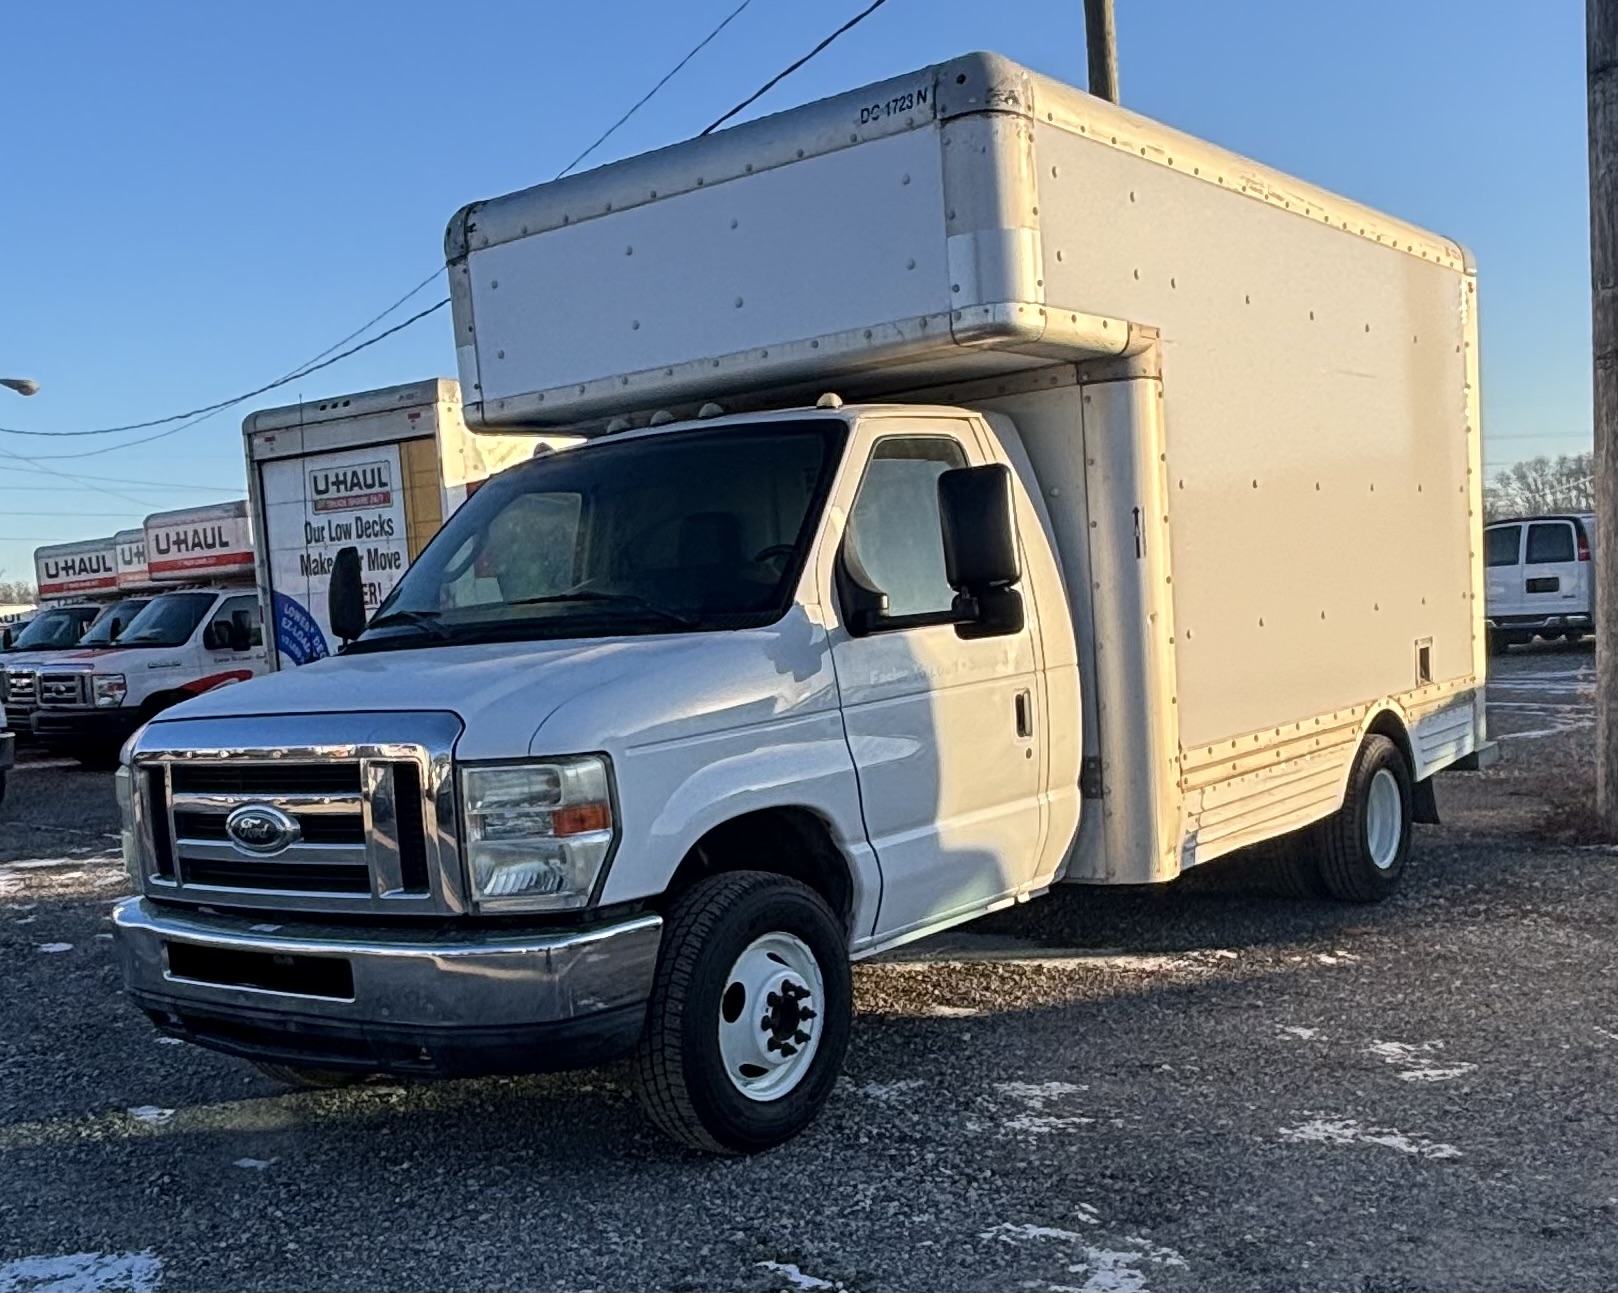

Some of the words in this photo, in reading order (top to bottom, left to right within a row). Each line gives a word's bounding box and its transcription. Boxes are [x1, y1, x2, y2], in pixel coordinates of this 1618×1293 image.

[860, 103, 880, 124] DC
[885, 93, 914, 117] 1723
[917, 87, 928, 105] N
[313, 467, 389, 495] U-HAUL
[155, 525, 230, 555] U-HAUL
[304, 521, 326, 545] Our
[328, 519, 352, 543] Low
[355, 514, 394, 539] Decks
[45, 554, 113, 579] U-HAUL
[121, 544, 145, 566] U-H
[300, 552, 333, 577] Make
[367, 548, 401, 572] Move
[362, 582, 383, 606] ER!
[239, 818, 269, 839] Ford
